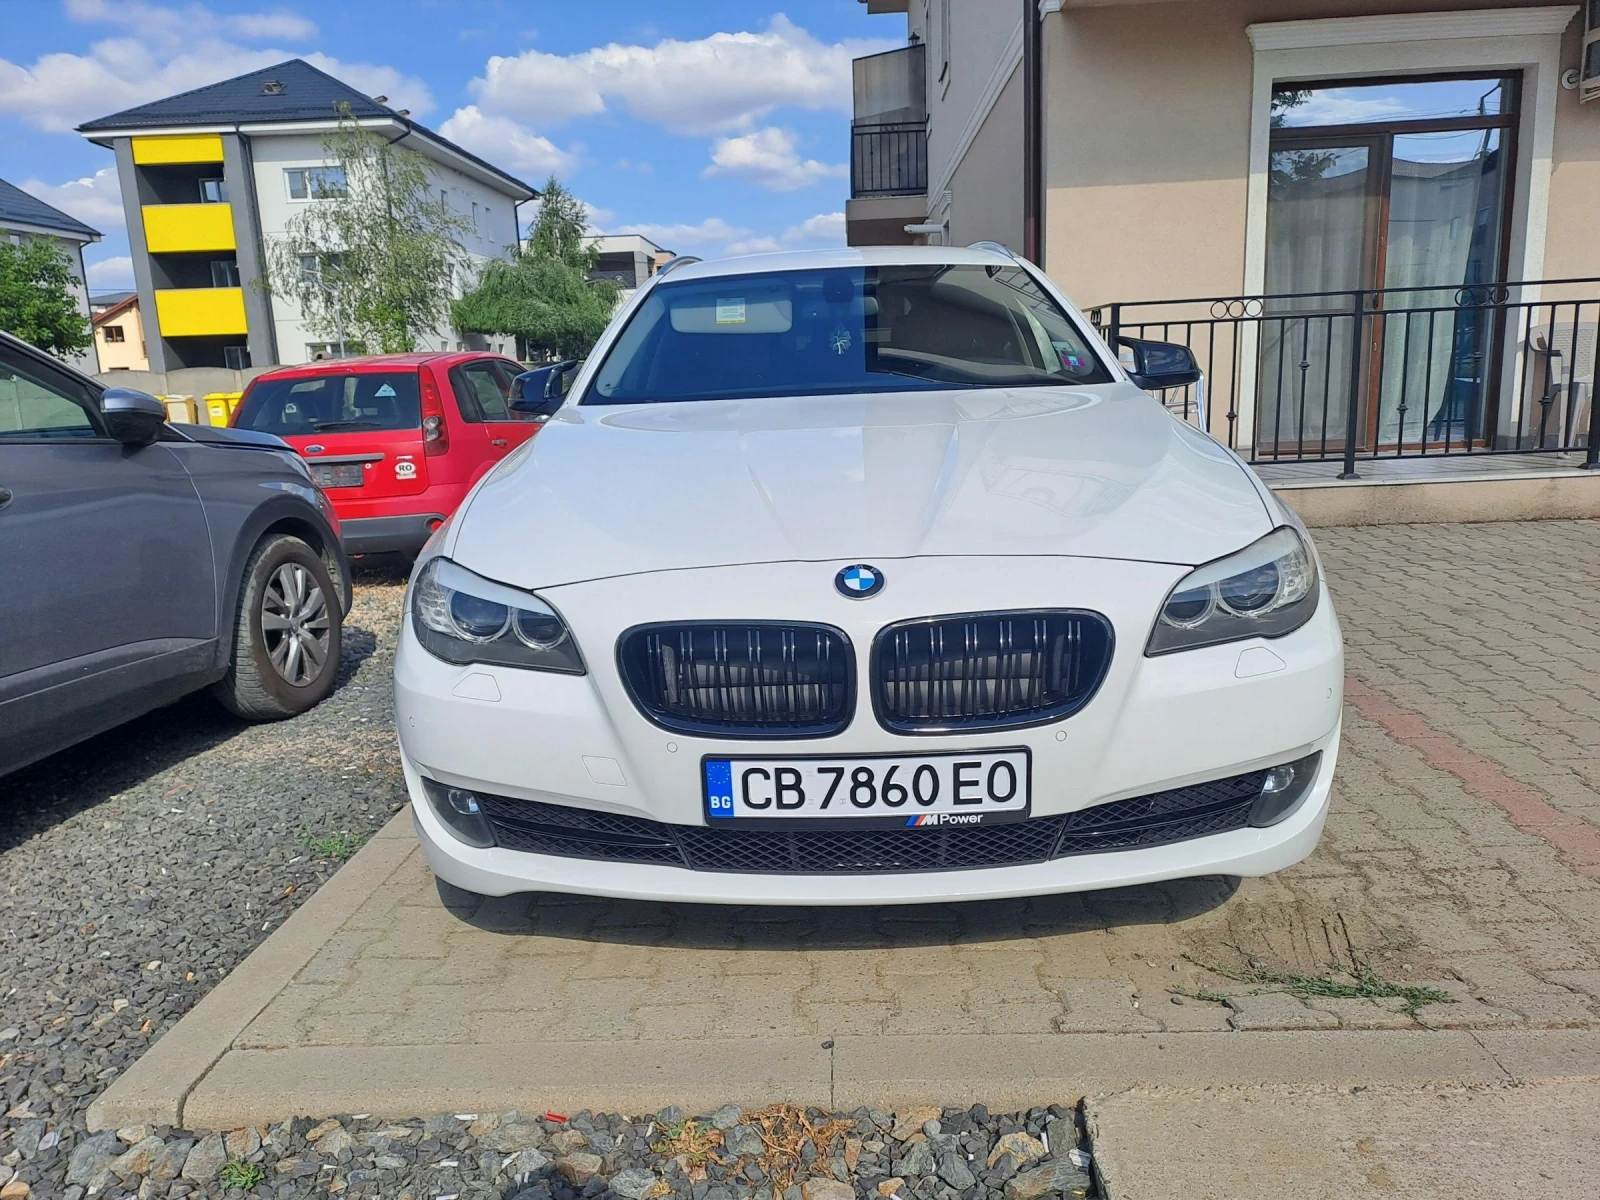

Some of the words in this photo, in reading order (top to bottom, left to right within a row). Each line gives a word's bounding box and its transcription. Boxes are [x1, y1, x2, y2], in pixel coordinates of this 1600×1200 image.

[741, 767, 806, 810] CB
[817, 764, 940, 810] 7860
[710, 796, 731, 809] BG
